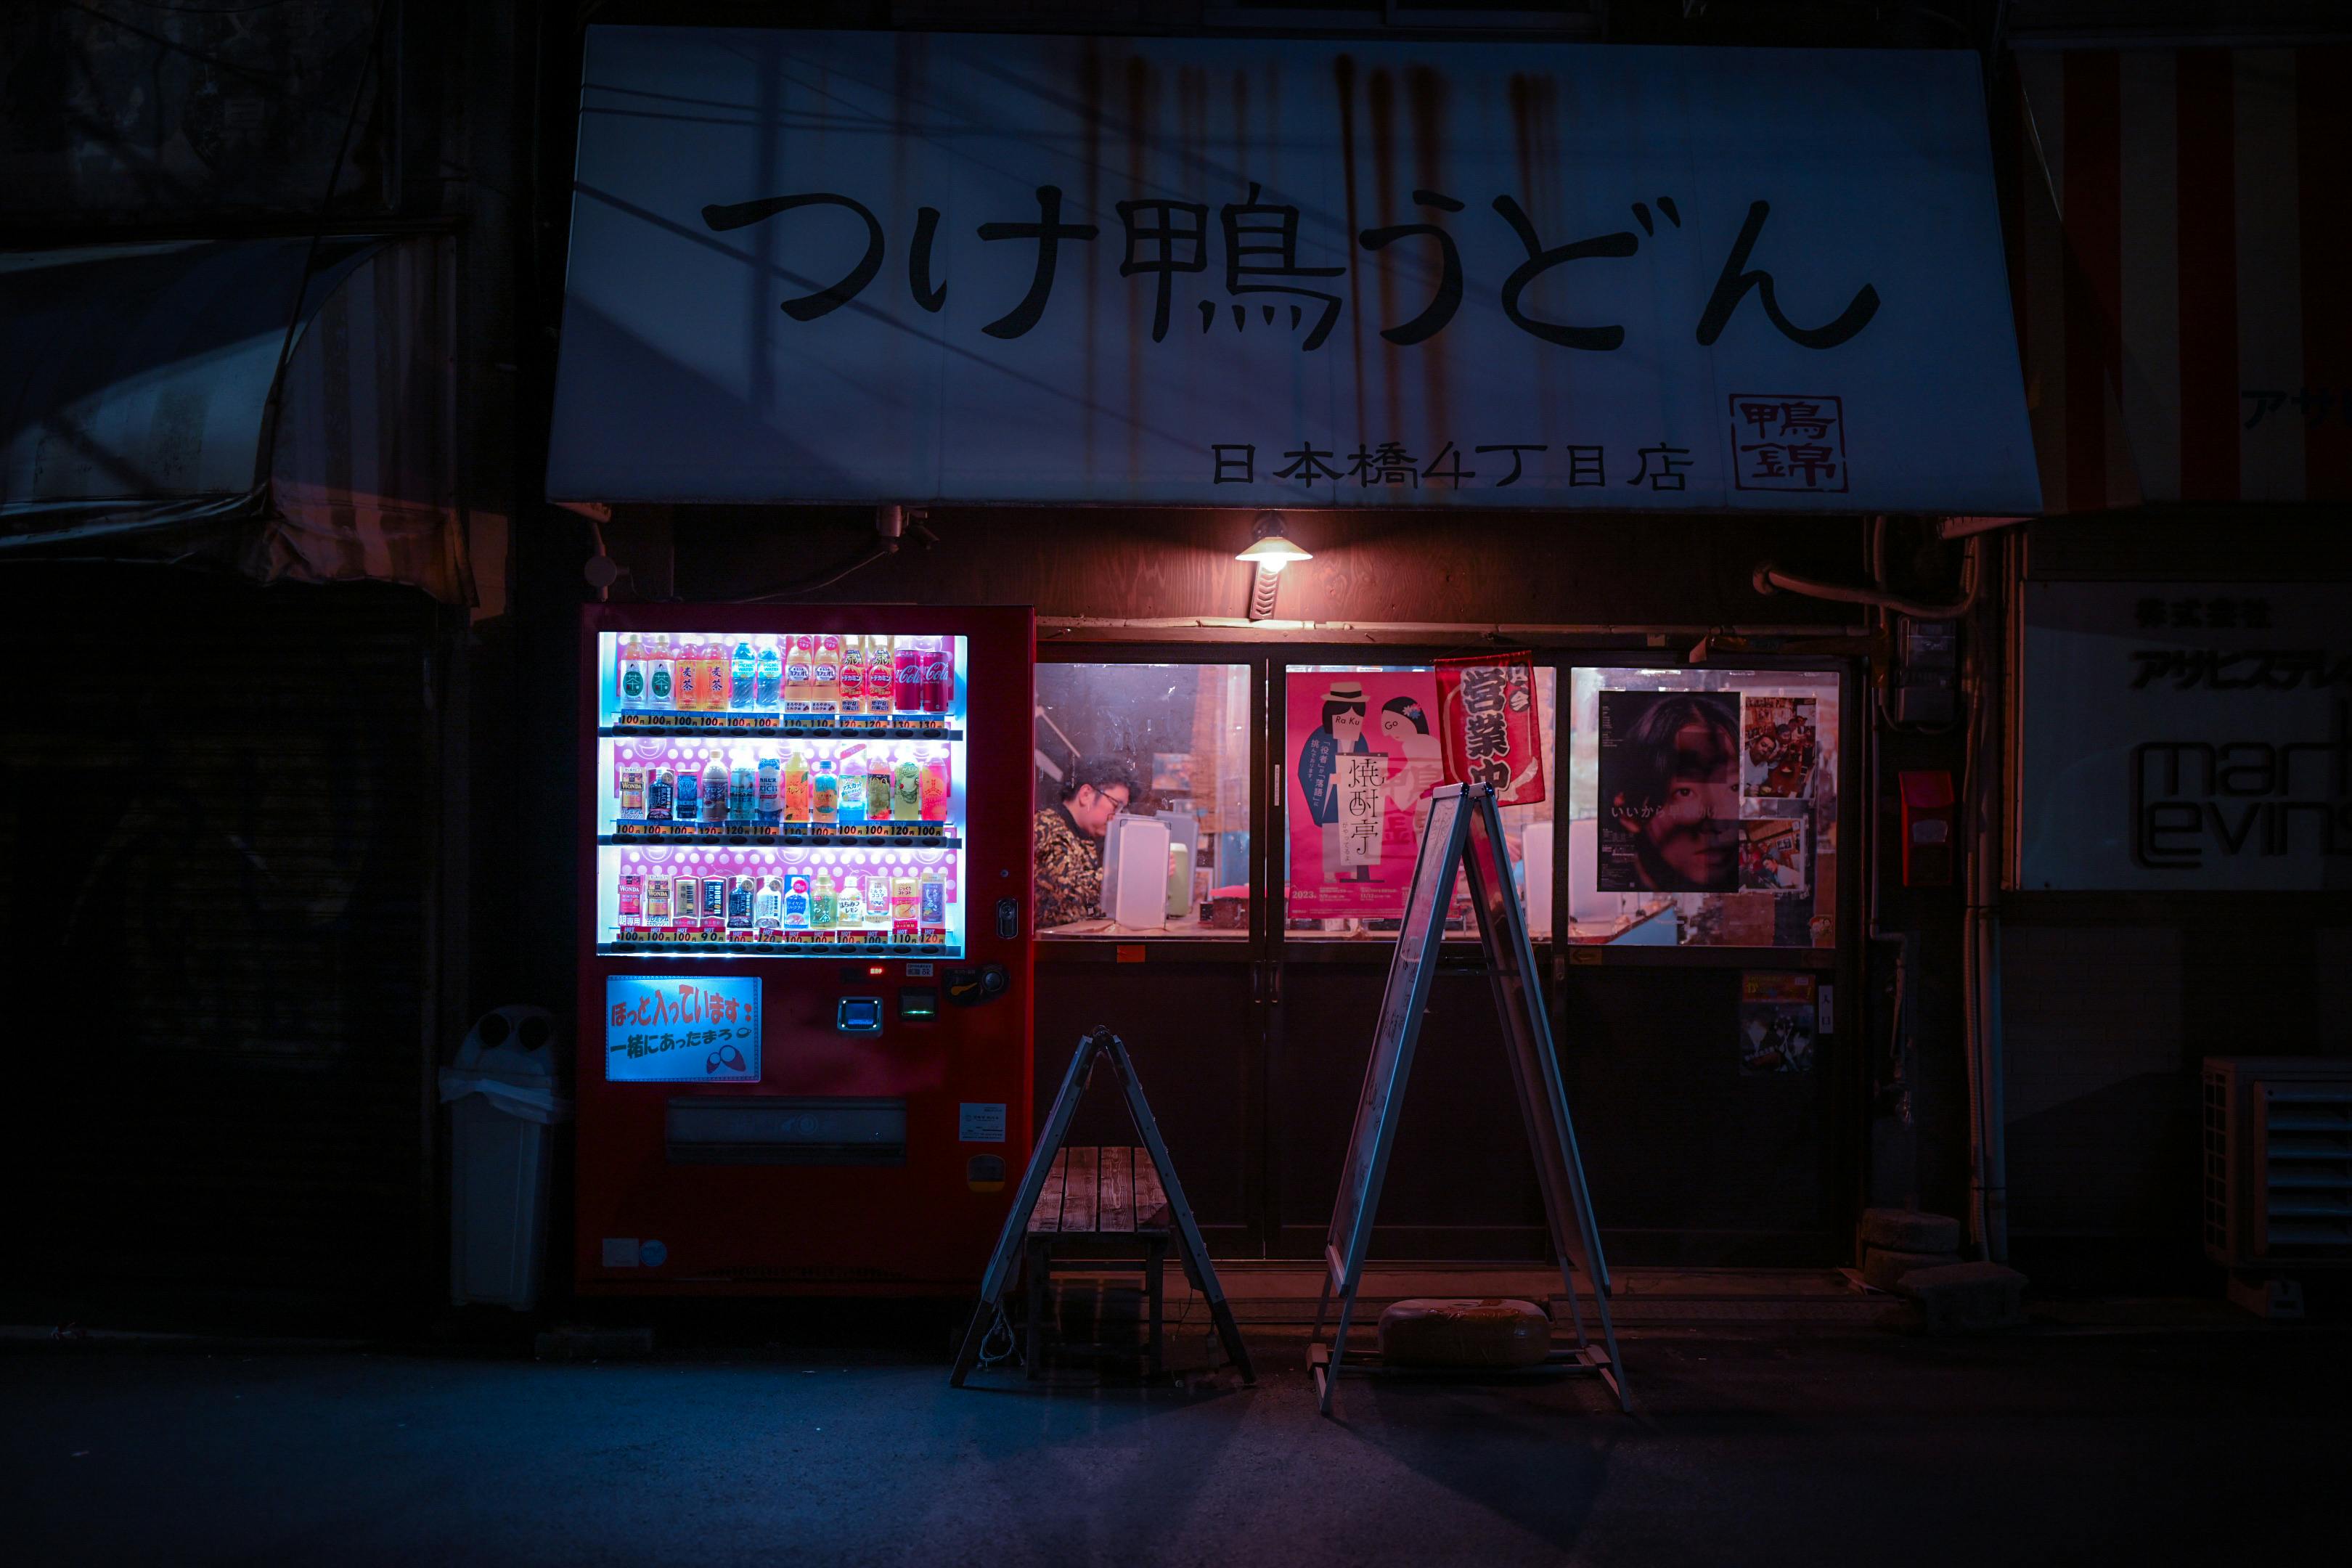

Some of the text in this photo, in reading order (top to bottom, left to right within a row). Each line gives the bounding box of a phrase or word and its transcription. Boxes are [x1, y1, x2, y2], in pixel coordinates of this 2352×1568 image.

[701, 181, 1880, 353] つけ鴨うどん
[1211, 441, 1694, 491] 日本橋4丁目店
[682, 666, 693, 690] 麦茶
[711, 666, 722, 690] 麦茶
[1335, 716, 1360, 726] Ra Ku
[1385, 721, 1398, 730] Go
[1462, 667, 1511, 791] 営業中
[1348, 759, 1384, 855] 焼酎亭
[618, 915, 640, 926] 朝専用
